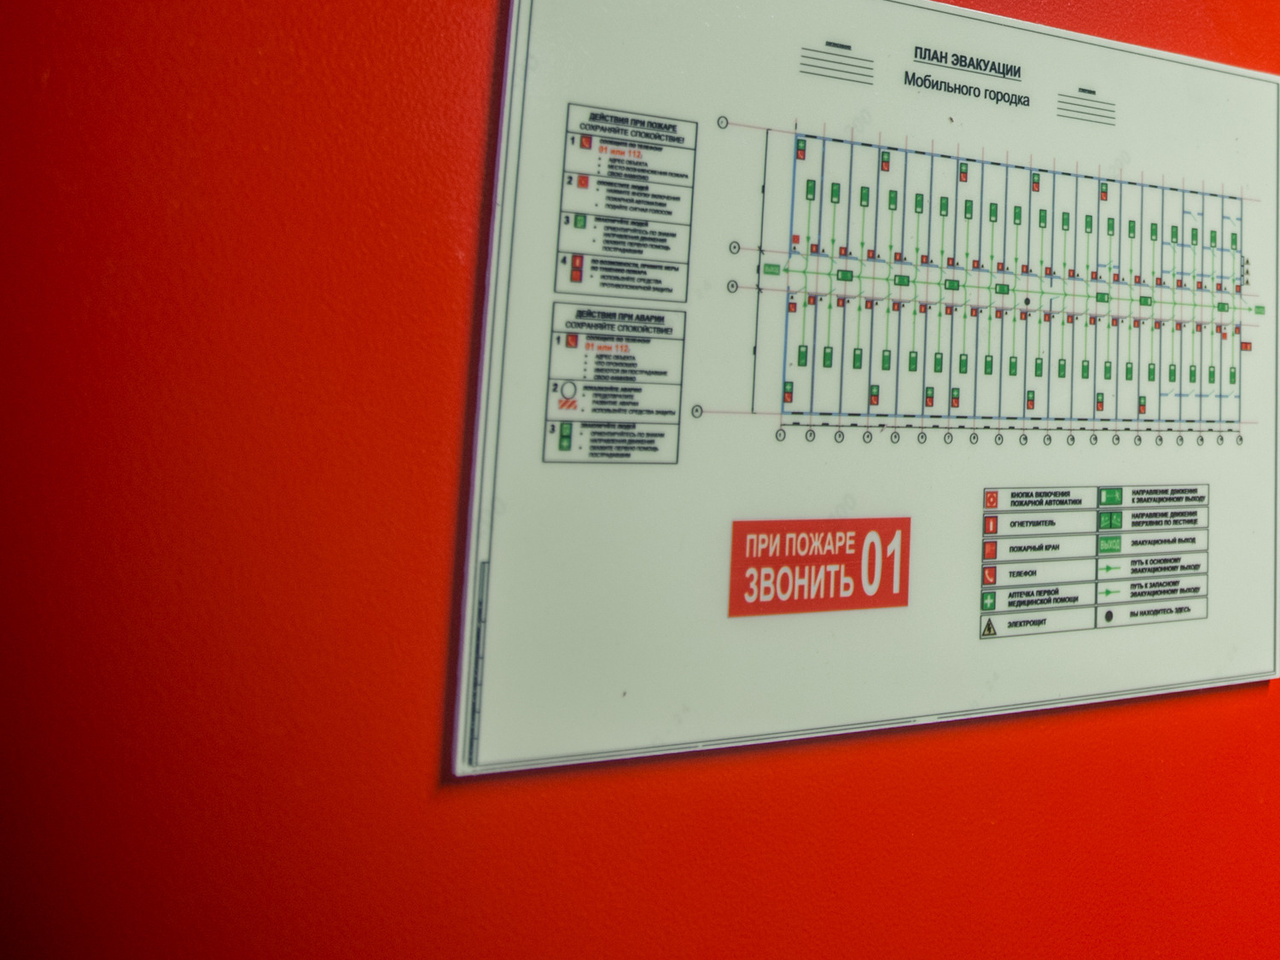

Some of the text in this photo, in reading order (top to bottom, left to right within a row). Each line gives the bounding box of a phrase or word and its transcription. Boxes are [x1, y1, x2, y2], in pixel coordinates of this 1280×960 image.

[914, 46, 1021, 78] ПЛАН ЭВАКУАЦИИ
[904, 70, 1030, 107] Мобильного городка
[589, 113, 677, 132] ДЕЙСТВИЯ ПРИ ПОЖАРЕ
[580, 123, 628, 137] СОХРАНЯЙТЕ
[630, 130, 685, 145] СПОКОЙСТВИЕ!
[576, 310, 665, 323] ДЕЙСТВИЯ ПРИ АВАРИИ
[565, 321, 673, 335] СОХРАНЯЙТЕ СПОКОЙСТВИЕ!
[1010, 520, 1056, 528] ОГНЕТУШИТЕЛЬ
[746, 531, 856, 557] ПРИ ПОЖАРЕ
[1009, 544, 1043, 553] ПОЖАРНЫЙ
[744, 530, 902, 603] ЗВОНИТЬ 01
[1009, 570, 1037, 578] ТЕЛЕФОН
[1008, 588, 1059, 599] АПТЕЧКА ПЕРВОЙ
[1008, 596, 1078, 608] МЕДИЦИНСКОЙ ПОМОЩИ
[1007, 619, 1047, 629] ЭЛЕКТРОЩИТ
